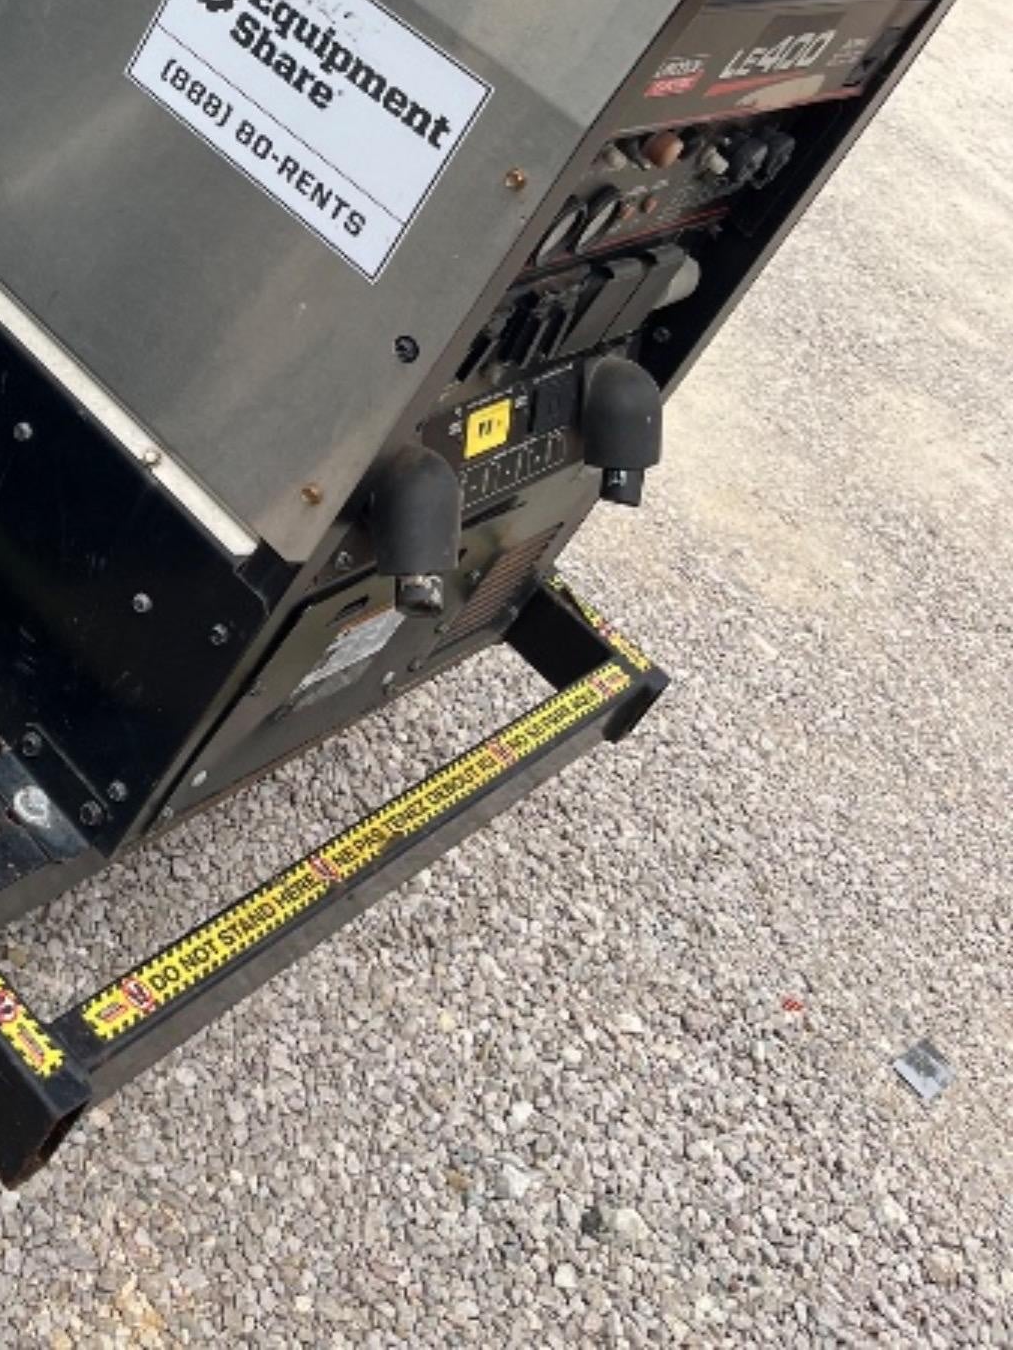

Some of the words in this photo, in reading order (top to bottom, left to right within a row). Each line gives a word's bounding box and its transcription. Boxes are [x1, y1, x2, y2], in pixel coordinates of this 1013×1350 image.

[230, 10, 335, 111] Share
[160, 57, 235, 128] (888)
[235, 125, 368, 238] 80-RENTS
[149, 964, 180, 991] DO
[179, 939, 219, 971] NOT
[218, 901, 277, 946] STAND
[275, 875, 320, 907] HERE
